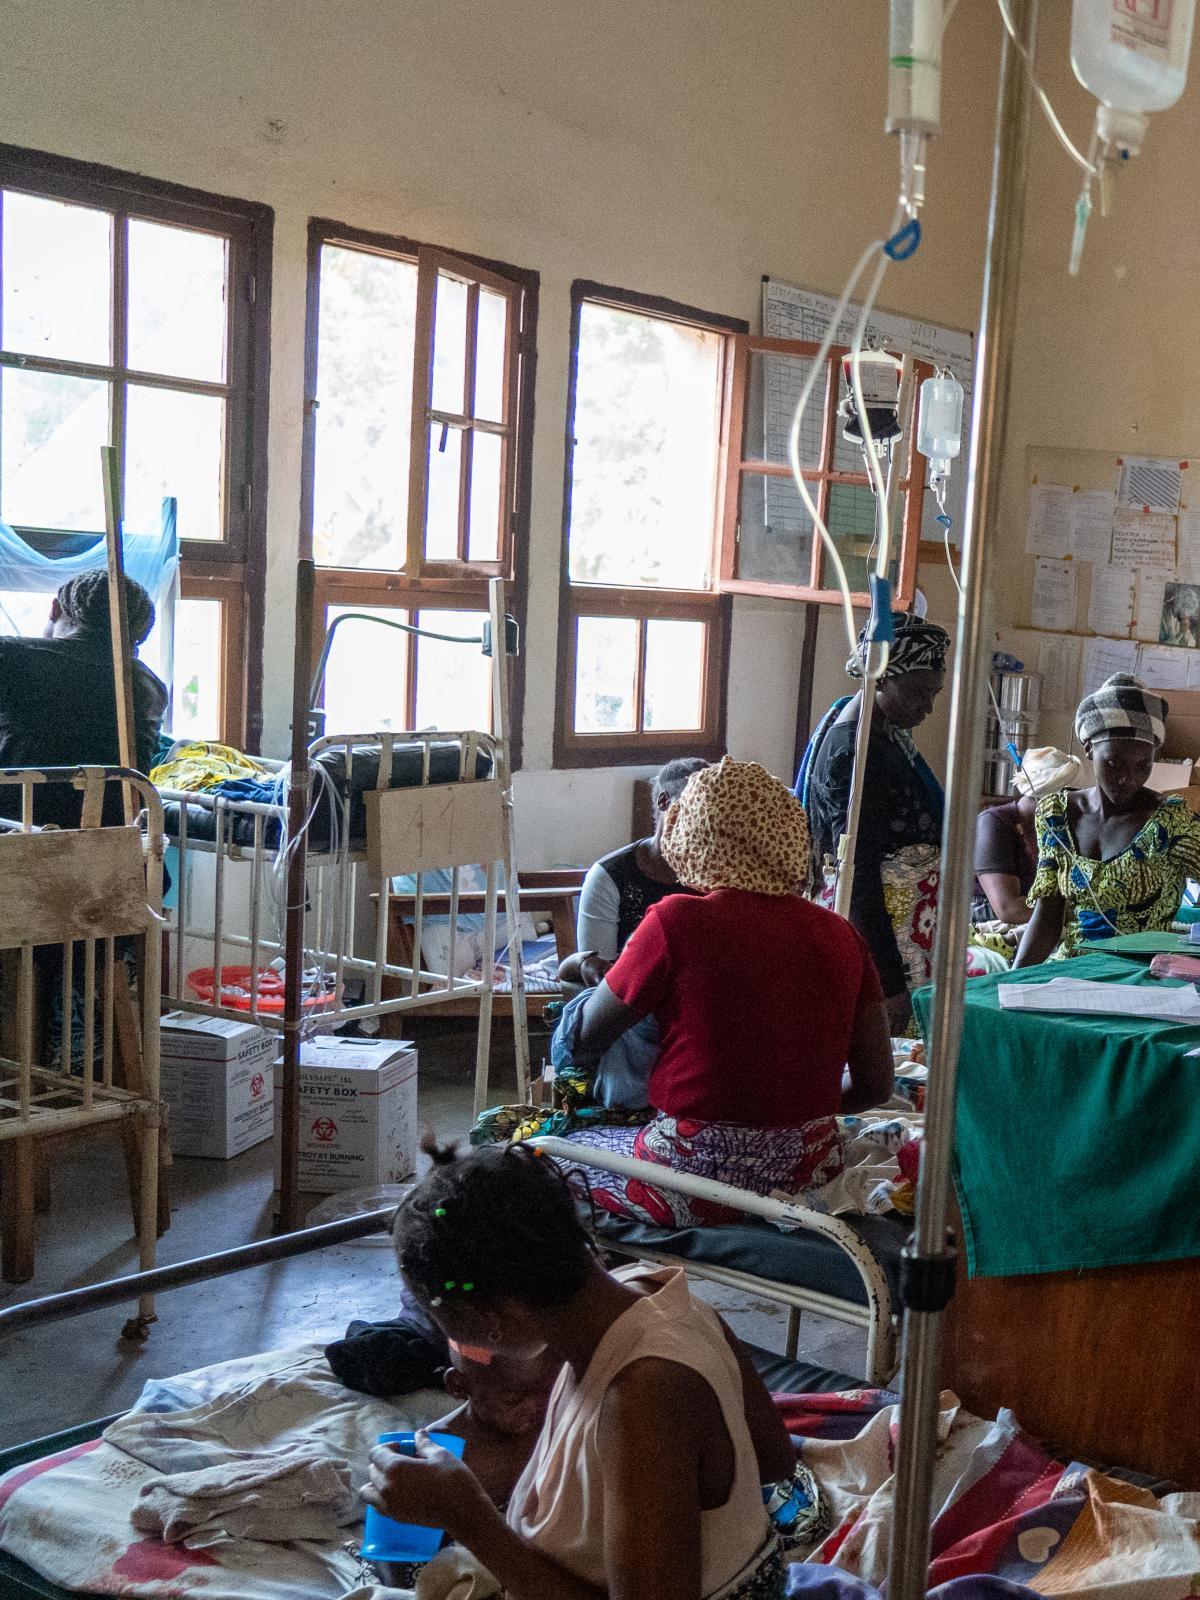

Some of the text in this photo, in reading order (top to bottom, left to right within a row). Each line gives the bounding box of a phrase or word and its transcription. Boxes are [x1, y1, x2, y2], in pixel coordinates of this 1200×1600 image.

[238, 1038, 273, 1060] SAFETY BOX
[333, 1087, 357, 1097] BOX
